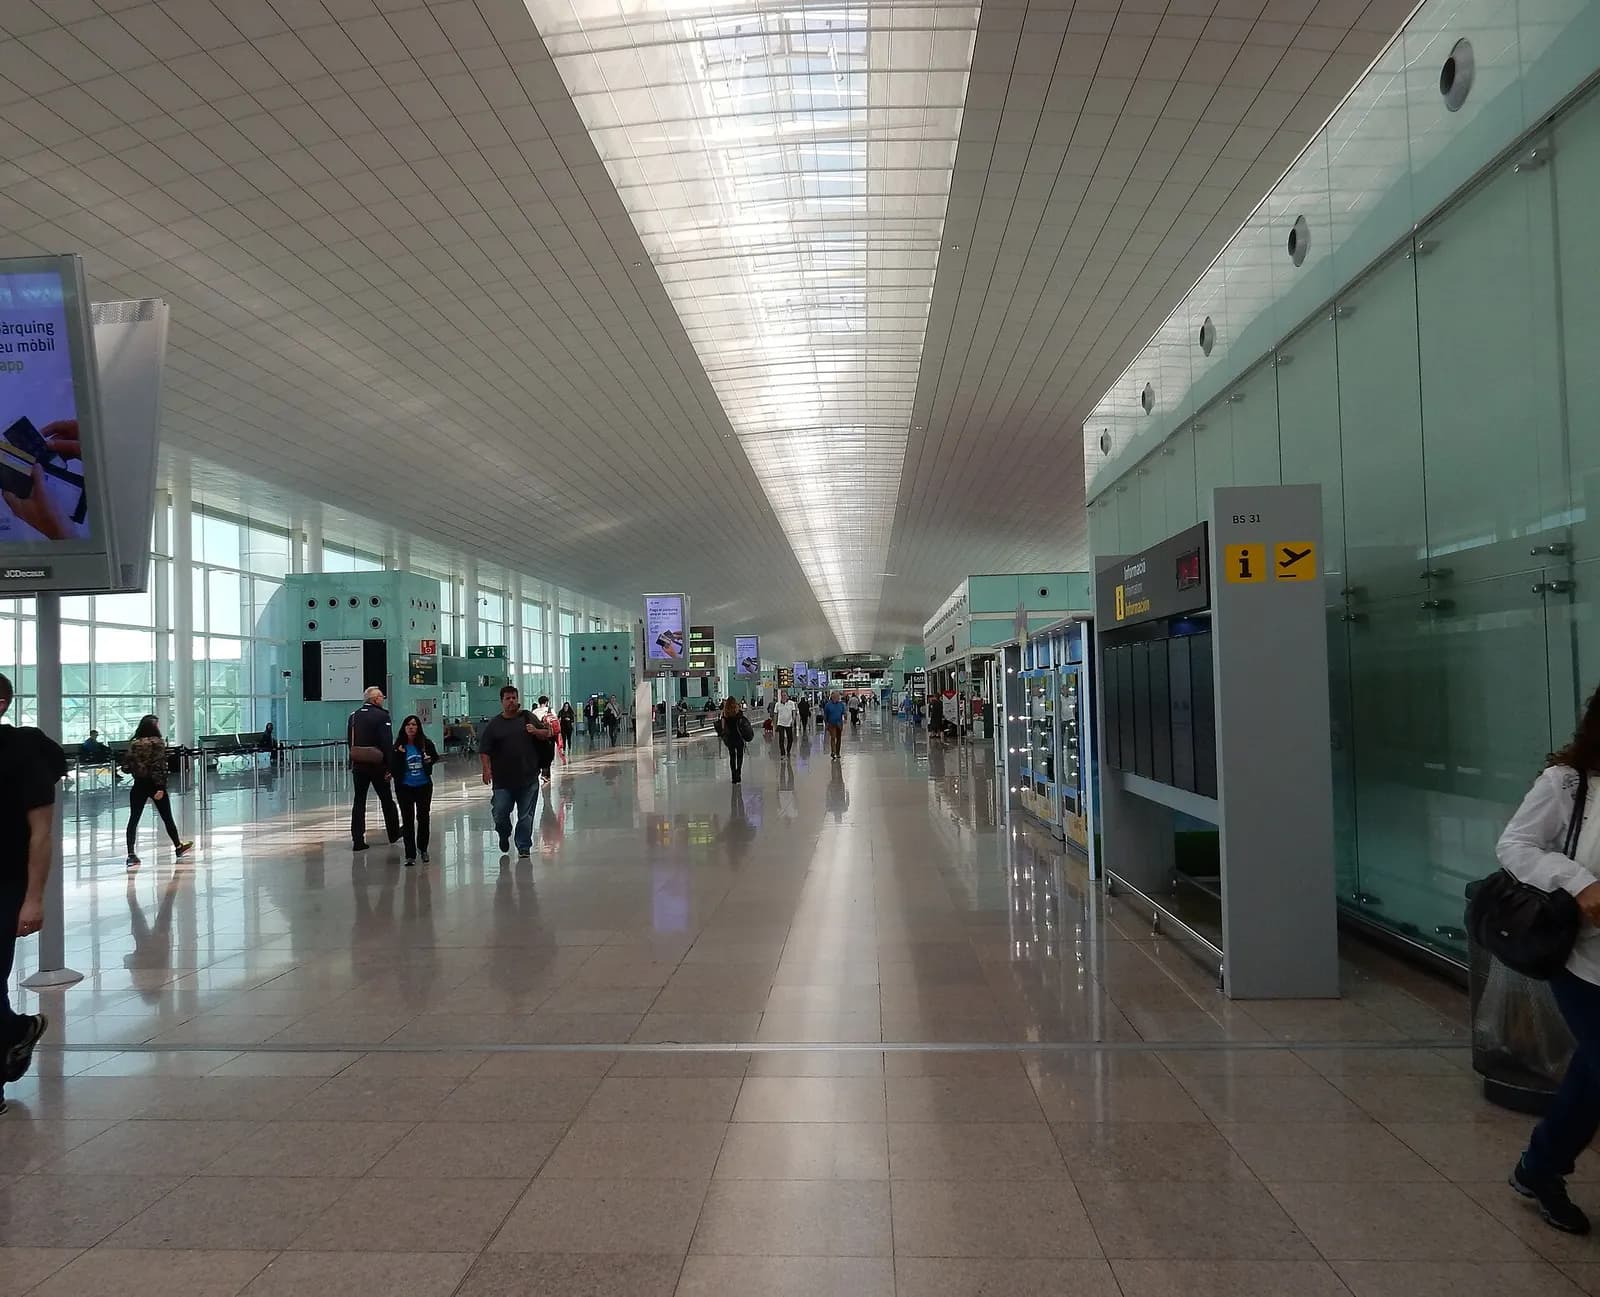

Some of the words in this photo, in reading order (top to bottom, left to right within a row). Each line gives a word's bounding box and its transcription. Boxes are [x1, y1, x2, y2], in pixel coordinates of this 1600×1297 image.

[0, 320, 55, 337] àrquing
[17, 338, 55, 352] mòbil
[1232, 515, 1246, 524] BS
[1249, 514, 1261, 524] 31
[4, 569, 46, 578] JCDecaux
